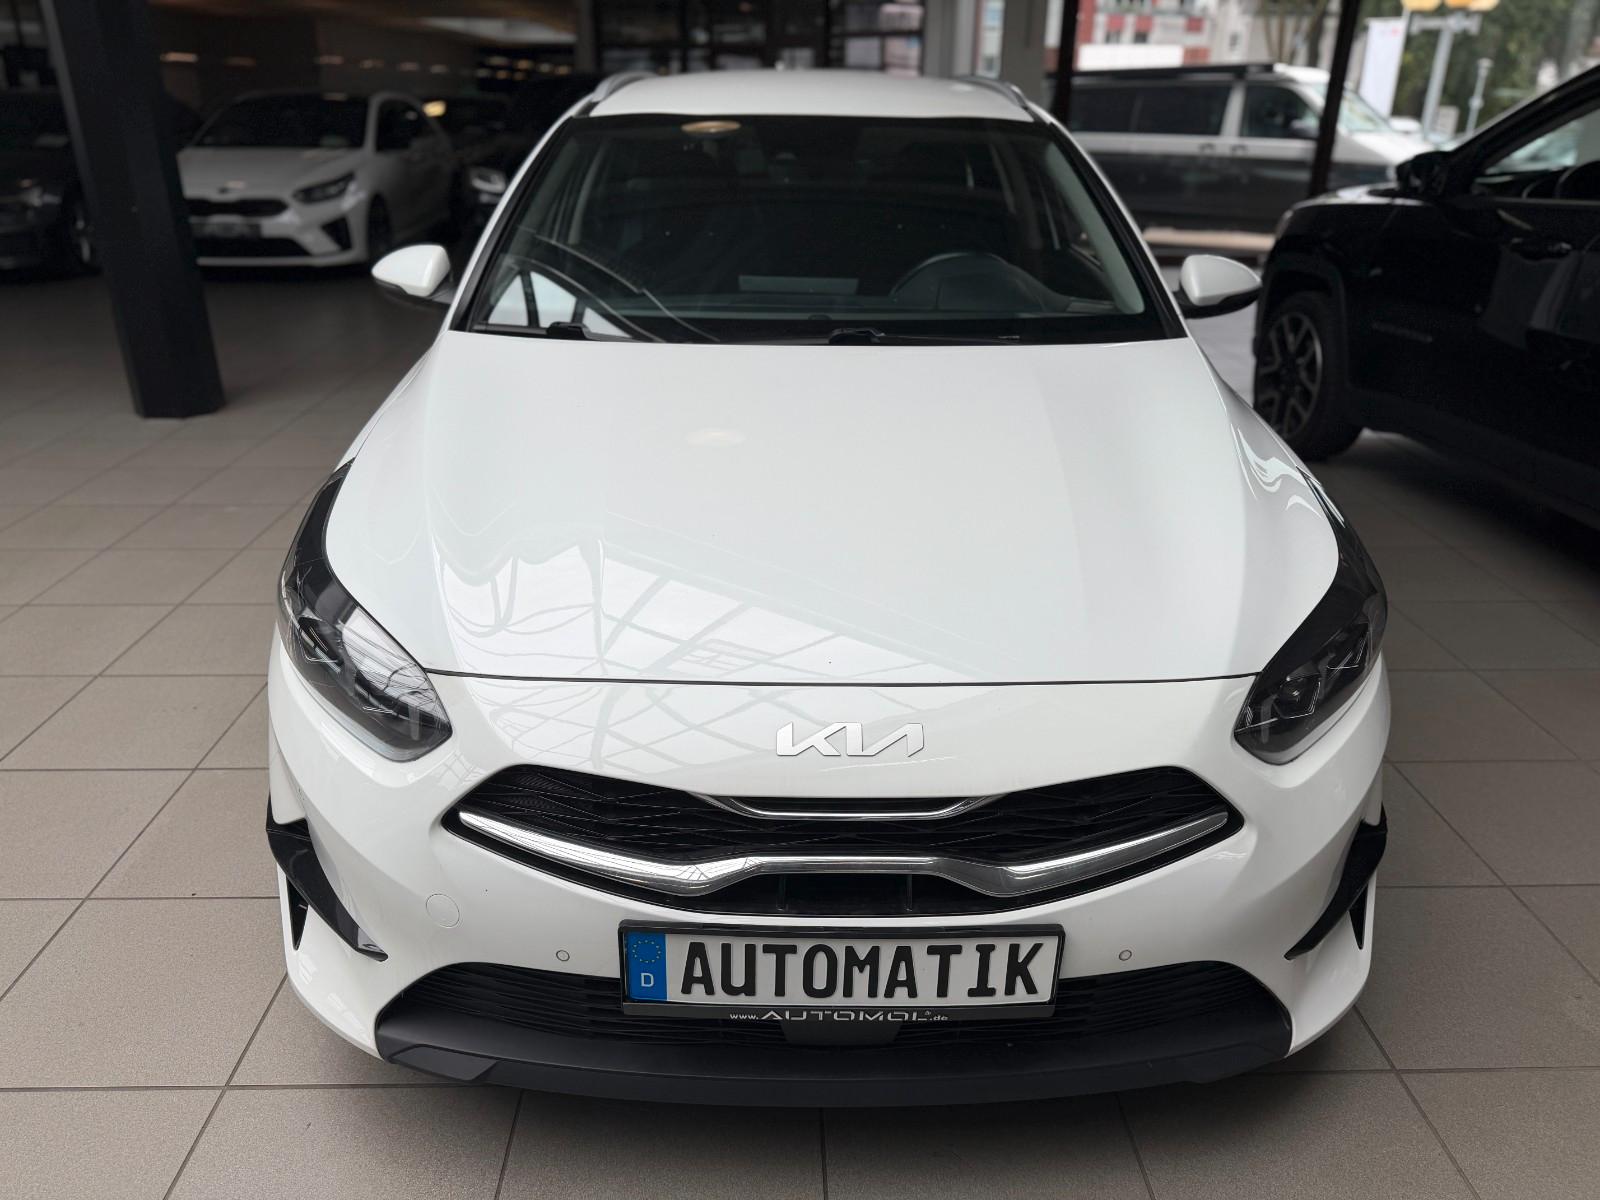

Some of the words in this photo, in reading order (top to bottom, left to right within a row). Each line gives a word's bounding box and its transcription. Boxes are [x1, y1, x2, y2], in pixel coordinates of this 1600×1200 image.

[776, 722, 924, 757] KIA
[640, 972, 654, 987] D
[680, 942, 1044, 998] AUTOMATIK
